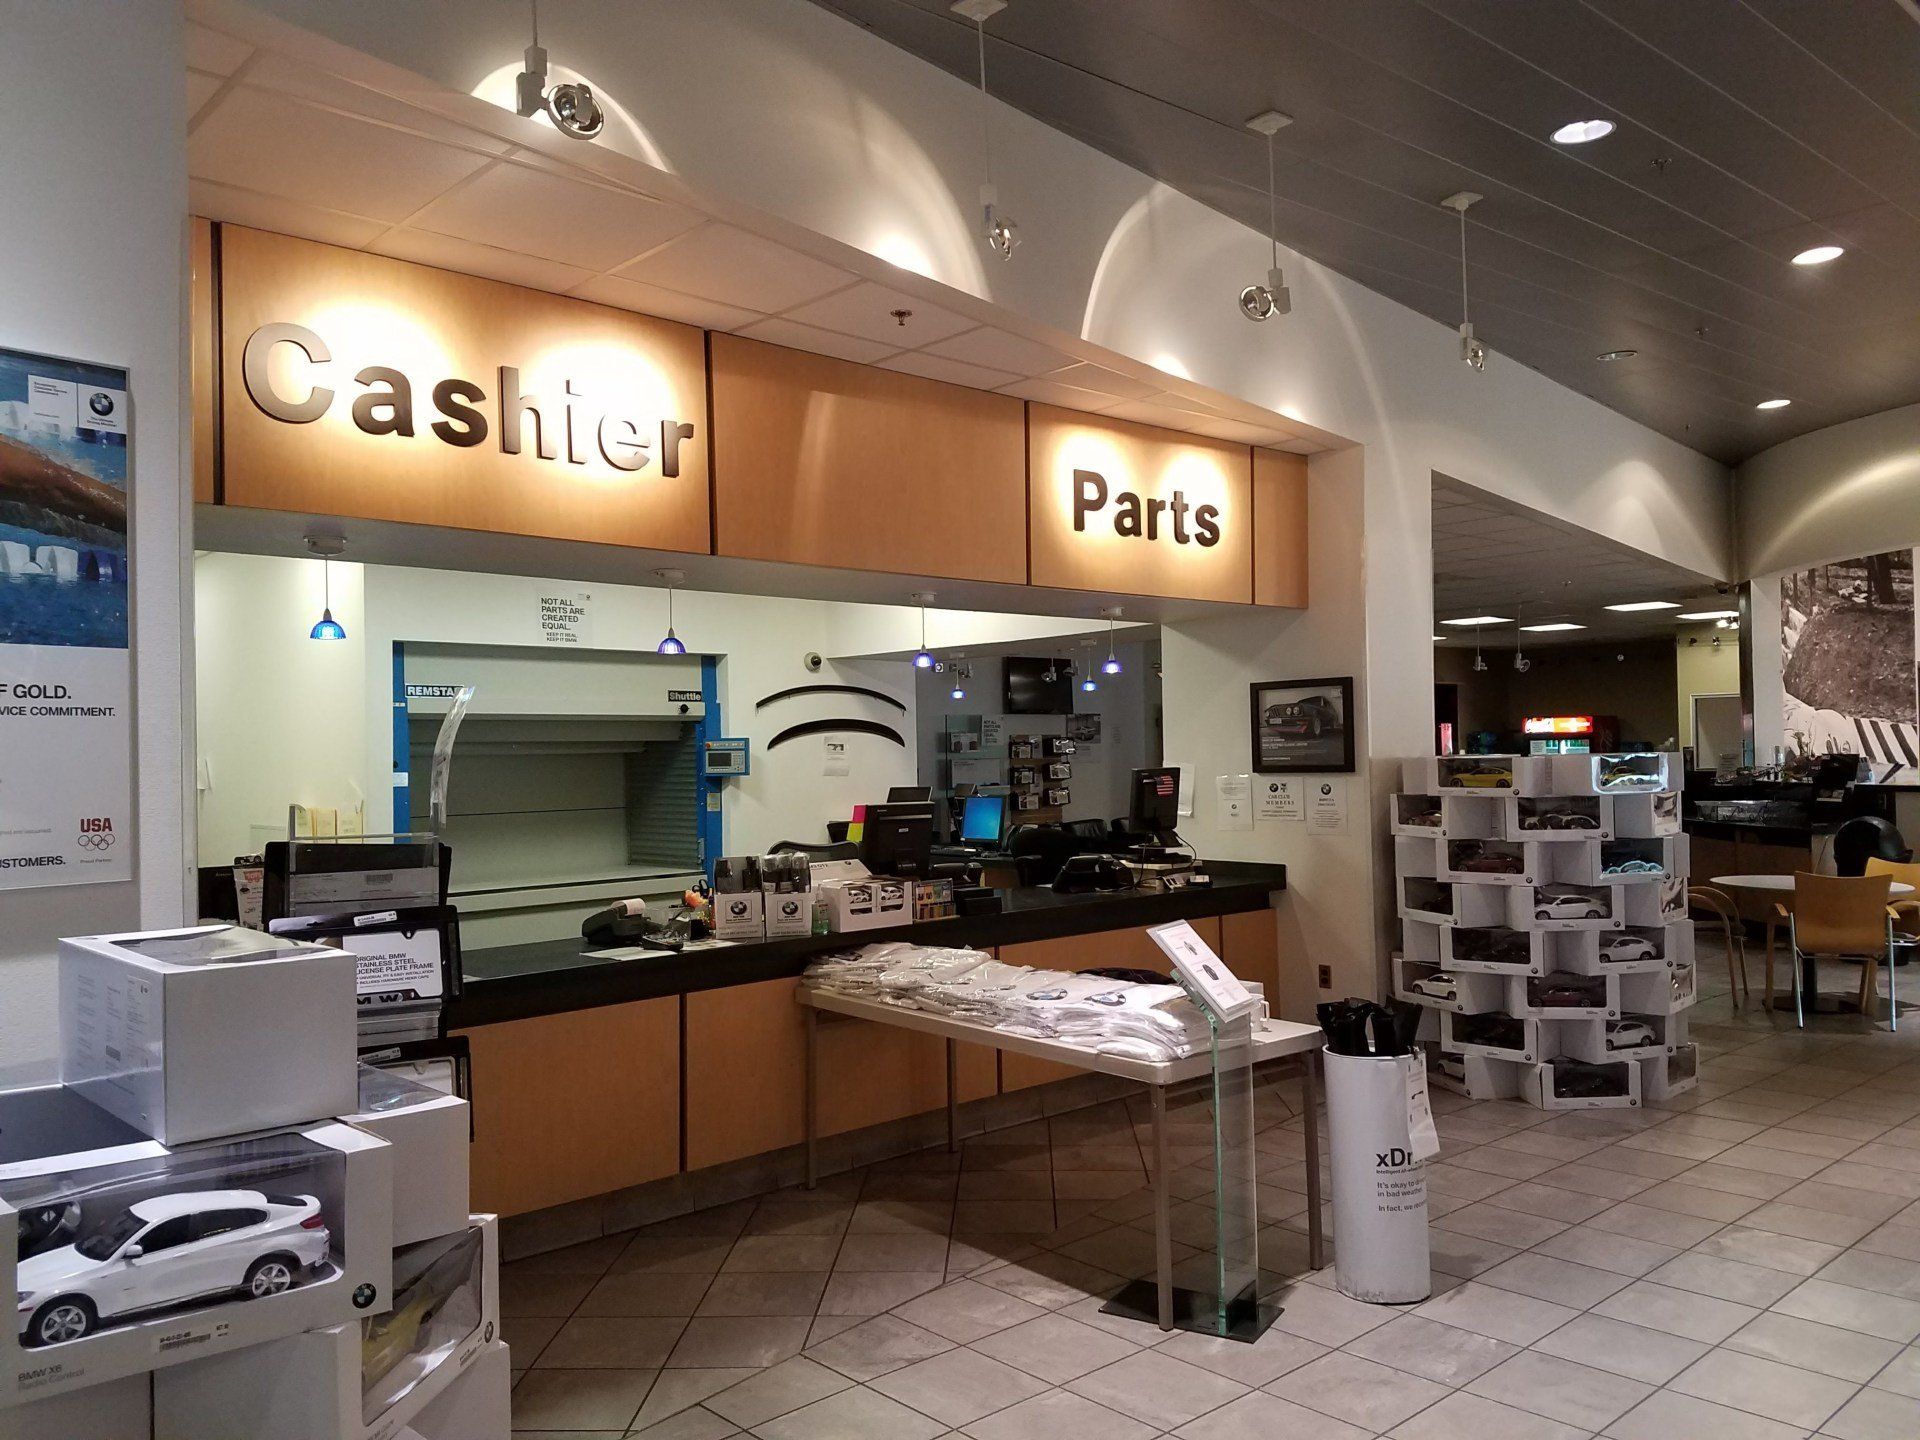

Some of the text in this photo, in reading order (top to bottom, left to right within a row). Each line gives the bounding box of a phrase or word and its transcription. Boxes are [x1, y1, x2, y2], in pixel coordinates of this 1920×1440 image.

[242, 322, 695, 478] Cashier
[1073, 469, 1220, 547] Parts
[541, 597, 575, 607] NOT ALL
[541, 606, 586, 616] PARTS ARE
[541, 614, 579, 623] CREATED
[13, 684, 72, 700] GOLD.
[669, 692, 702, 701] Shuttle
[30, 706, 116, 717] COMMITMENT.
[80, 818, 113, 833] USA
[389, 952, 406, 960] BMW
[386, 964, 408, 972] PLATE
[410, 962, 434, 970] FRAME
[394, 958, 417, 966] STEEL
[18, 1367, 47, 1382] BMW
